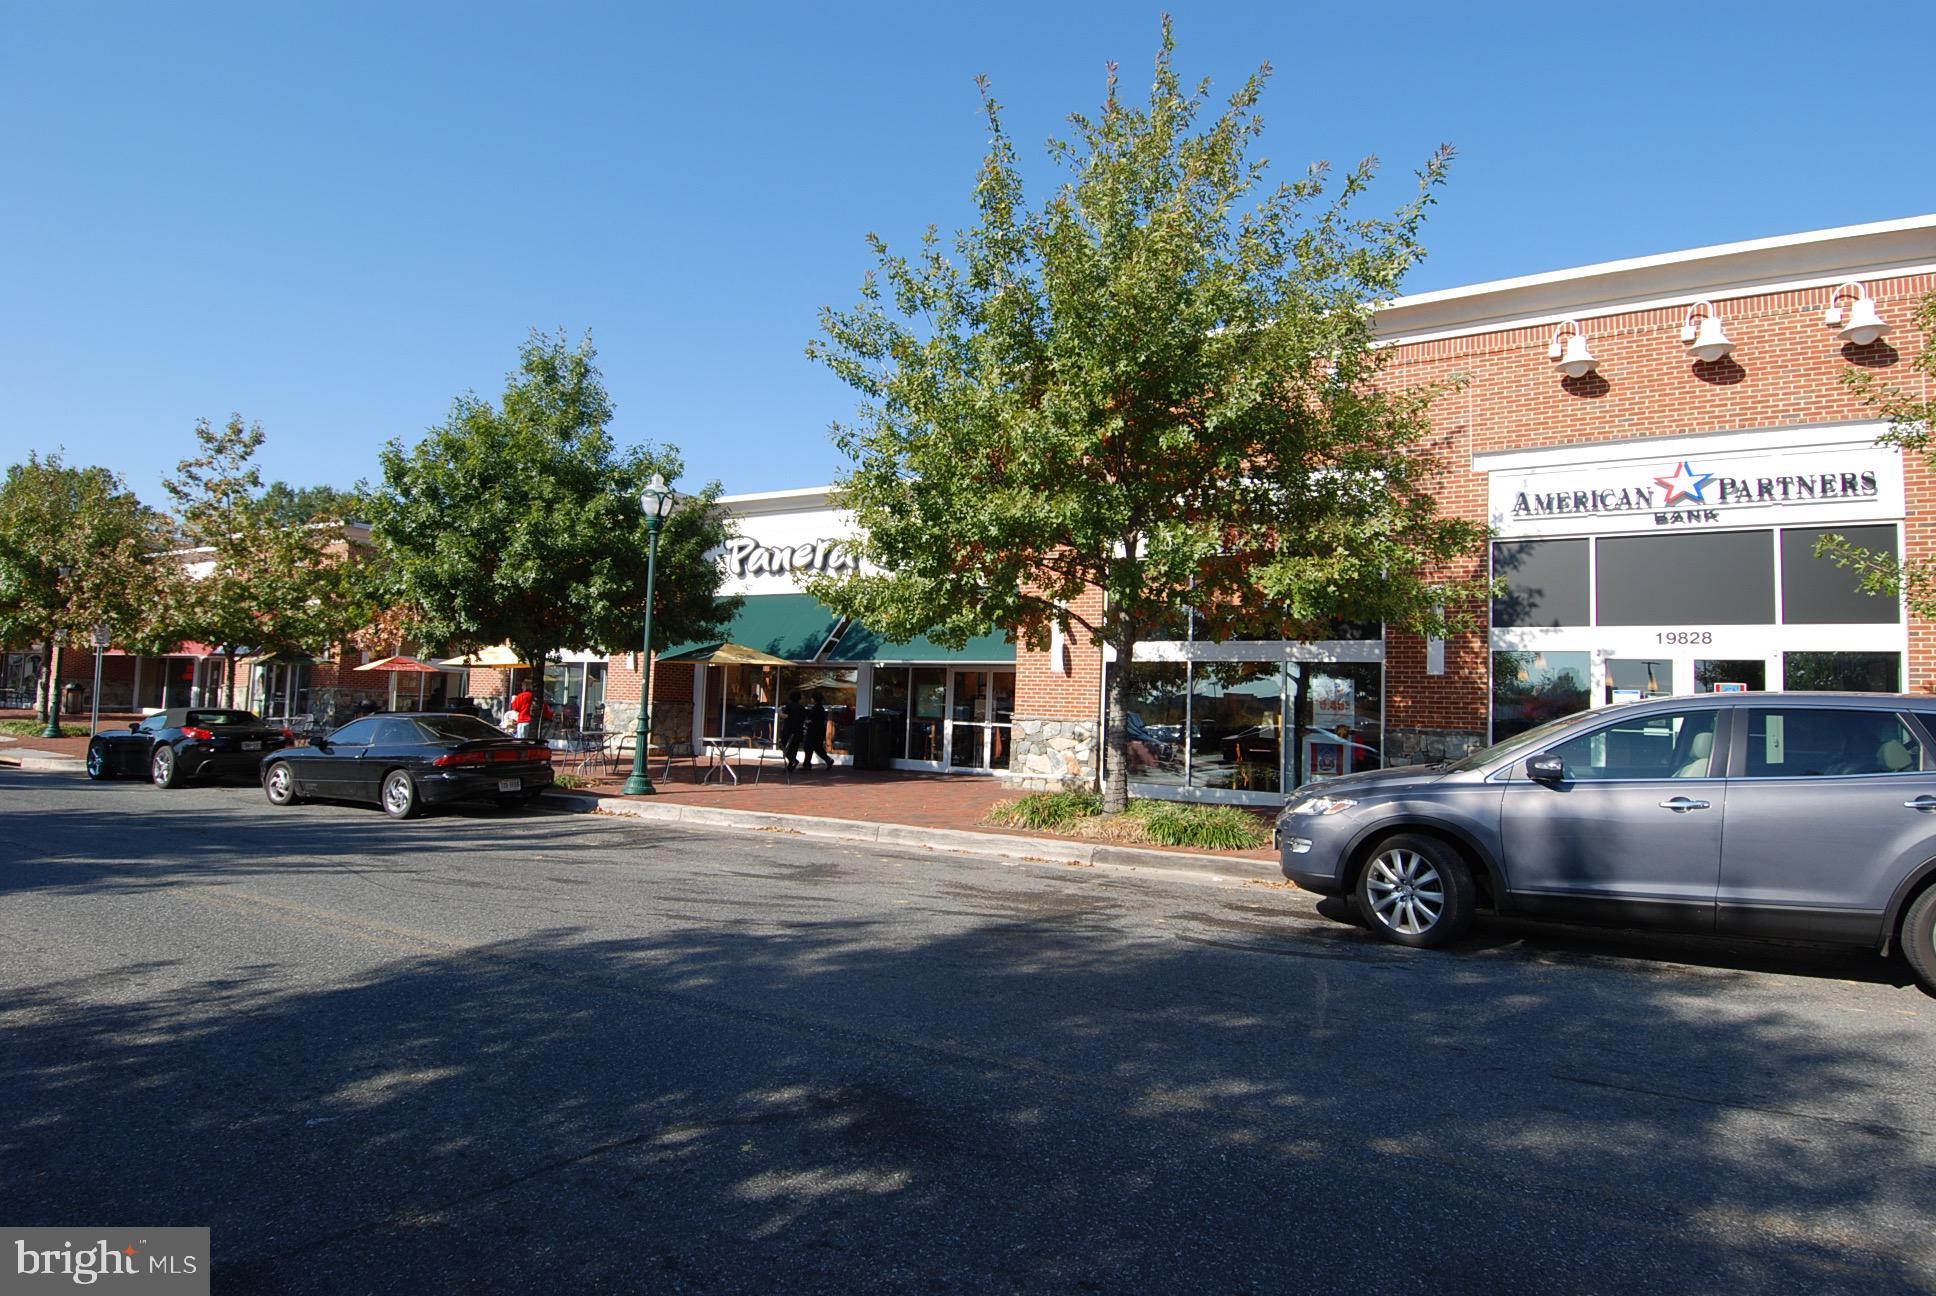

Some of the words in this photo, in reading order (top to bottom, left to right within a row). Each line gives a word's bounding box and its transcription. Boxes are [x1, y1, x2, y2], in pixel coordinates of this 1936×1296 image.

[1512, 487, 1654, 516] AMERICAN
[1719, 471, 1878, 504] PARTNERS
[1654, 508, 1719, 525] BANK
[725, 536, 860, 578] Panera
[1656, 632, 1712, 644] 19828
